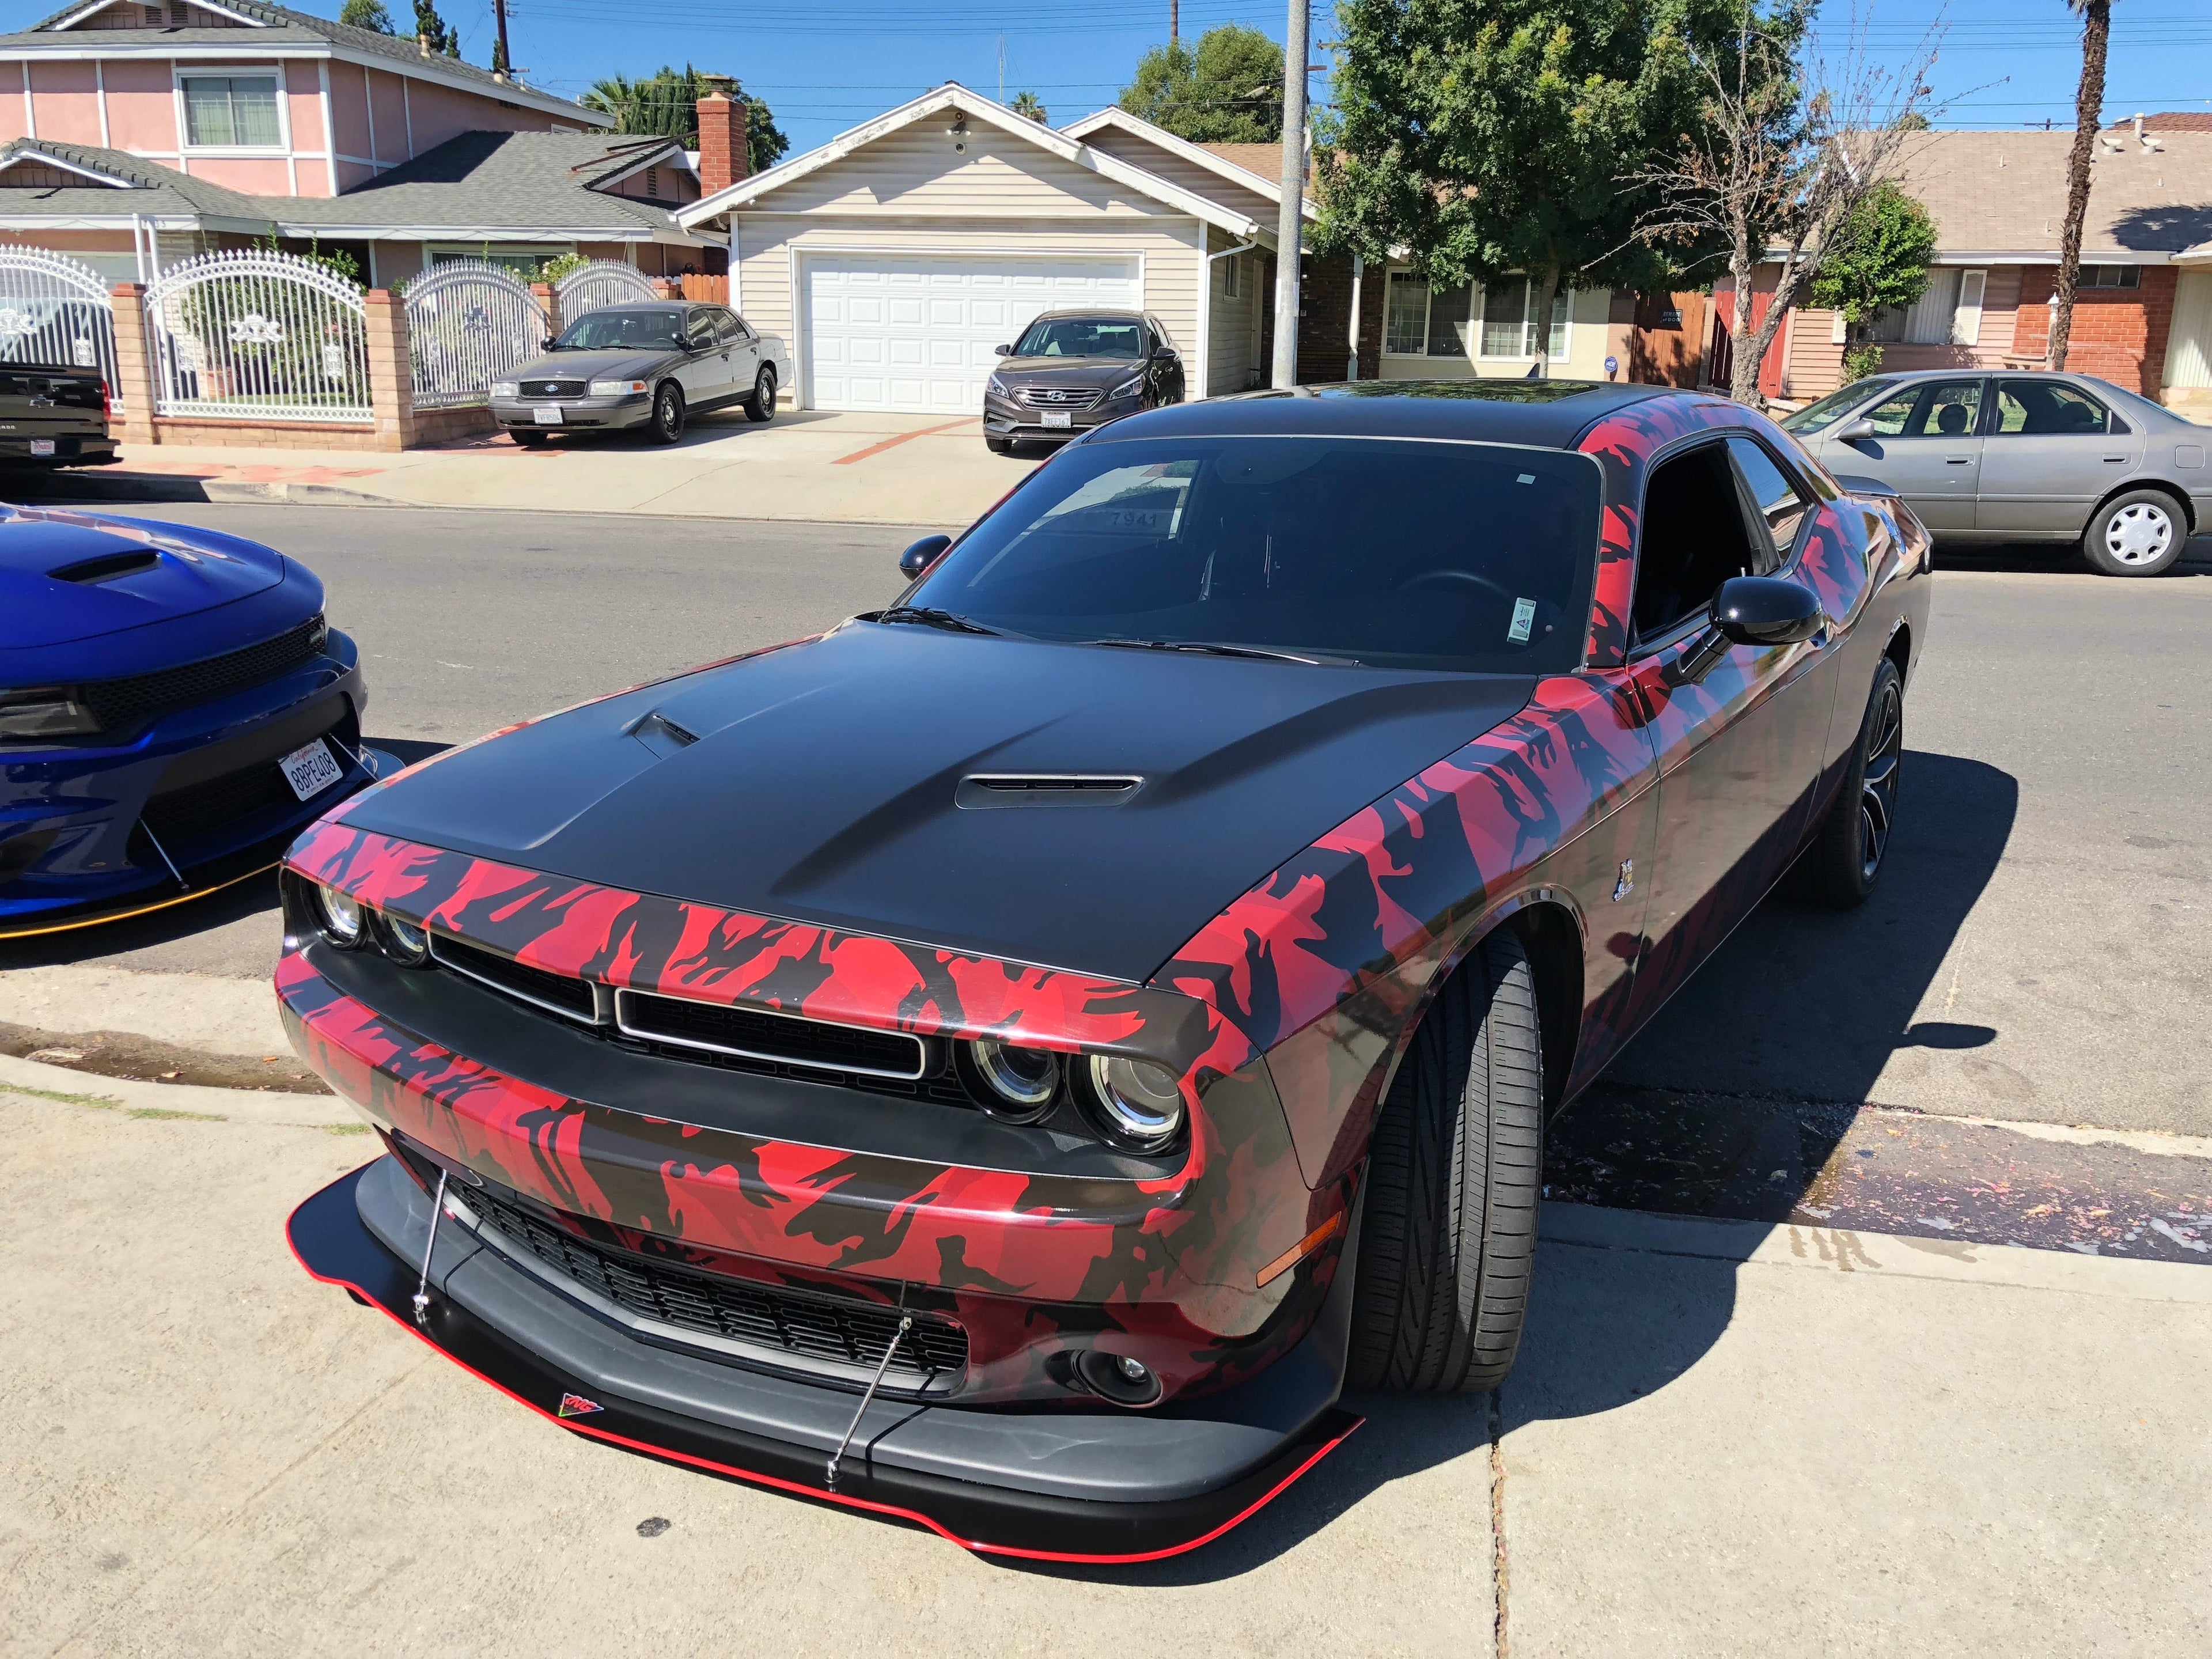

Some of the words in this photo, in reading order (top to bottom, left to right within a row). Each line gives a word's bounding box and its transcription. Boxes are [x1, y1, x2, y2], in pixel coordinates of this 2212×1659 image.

[1111, 512, 1157, 527] 7941
[290, 745, 319, 764] California
[290, 752, 336, 791] 8BPE408
